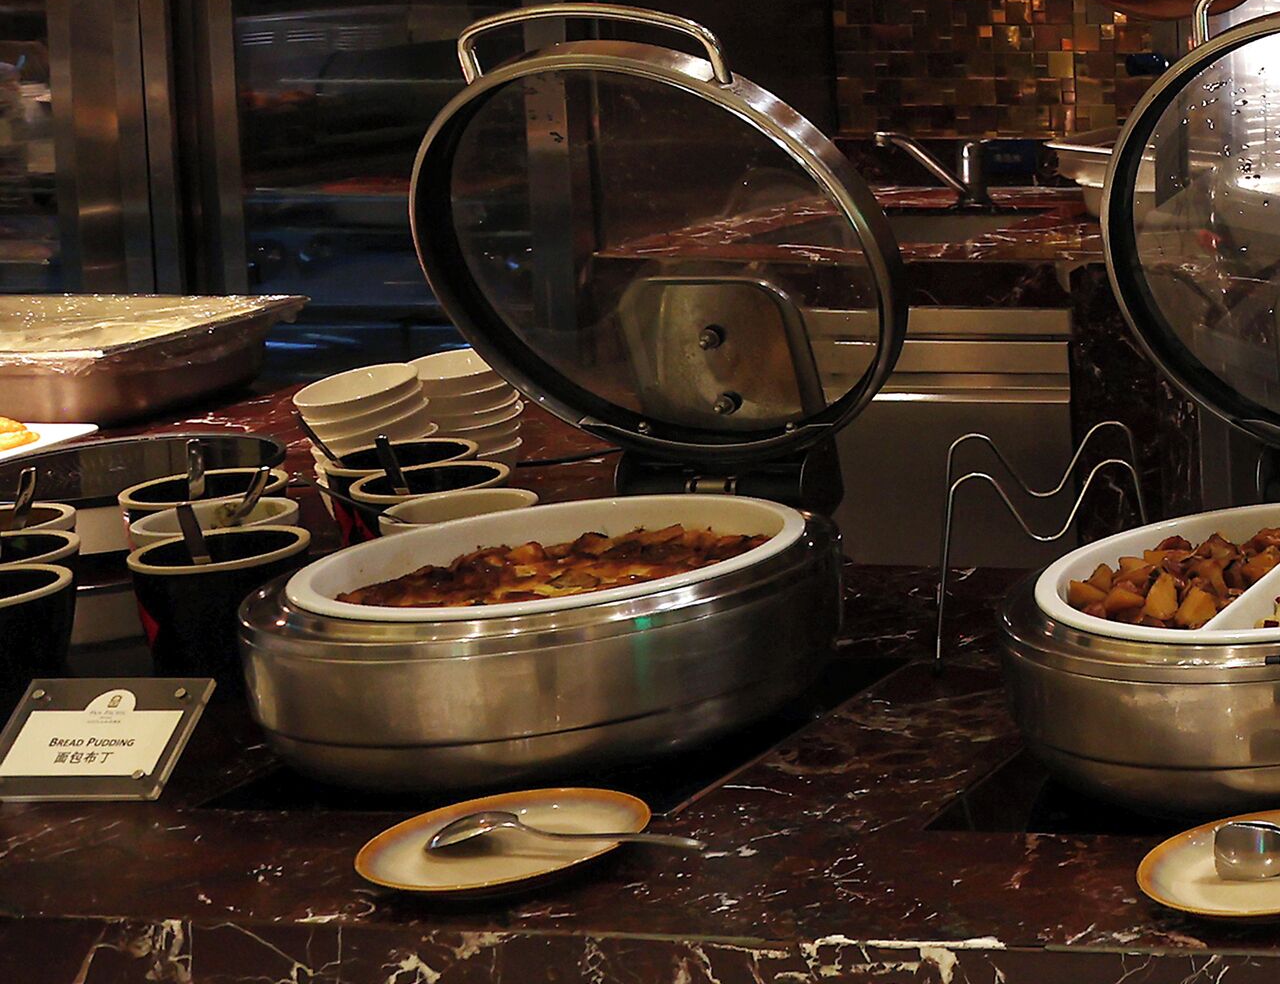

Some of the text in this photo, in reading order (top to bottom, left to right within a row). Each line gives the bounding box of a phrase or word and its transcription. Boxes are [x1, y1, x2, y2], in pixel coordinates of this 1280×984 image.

[48, 737, 136, 747] BREAD PUDDING
[53, 751, 115, 764] 面包布丁
